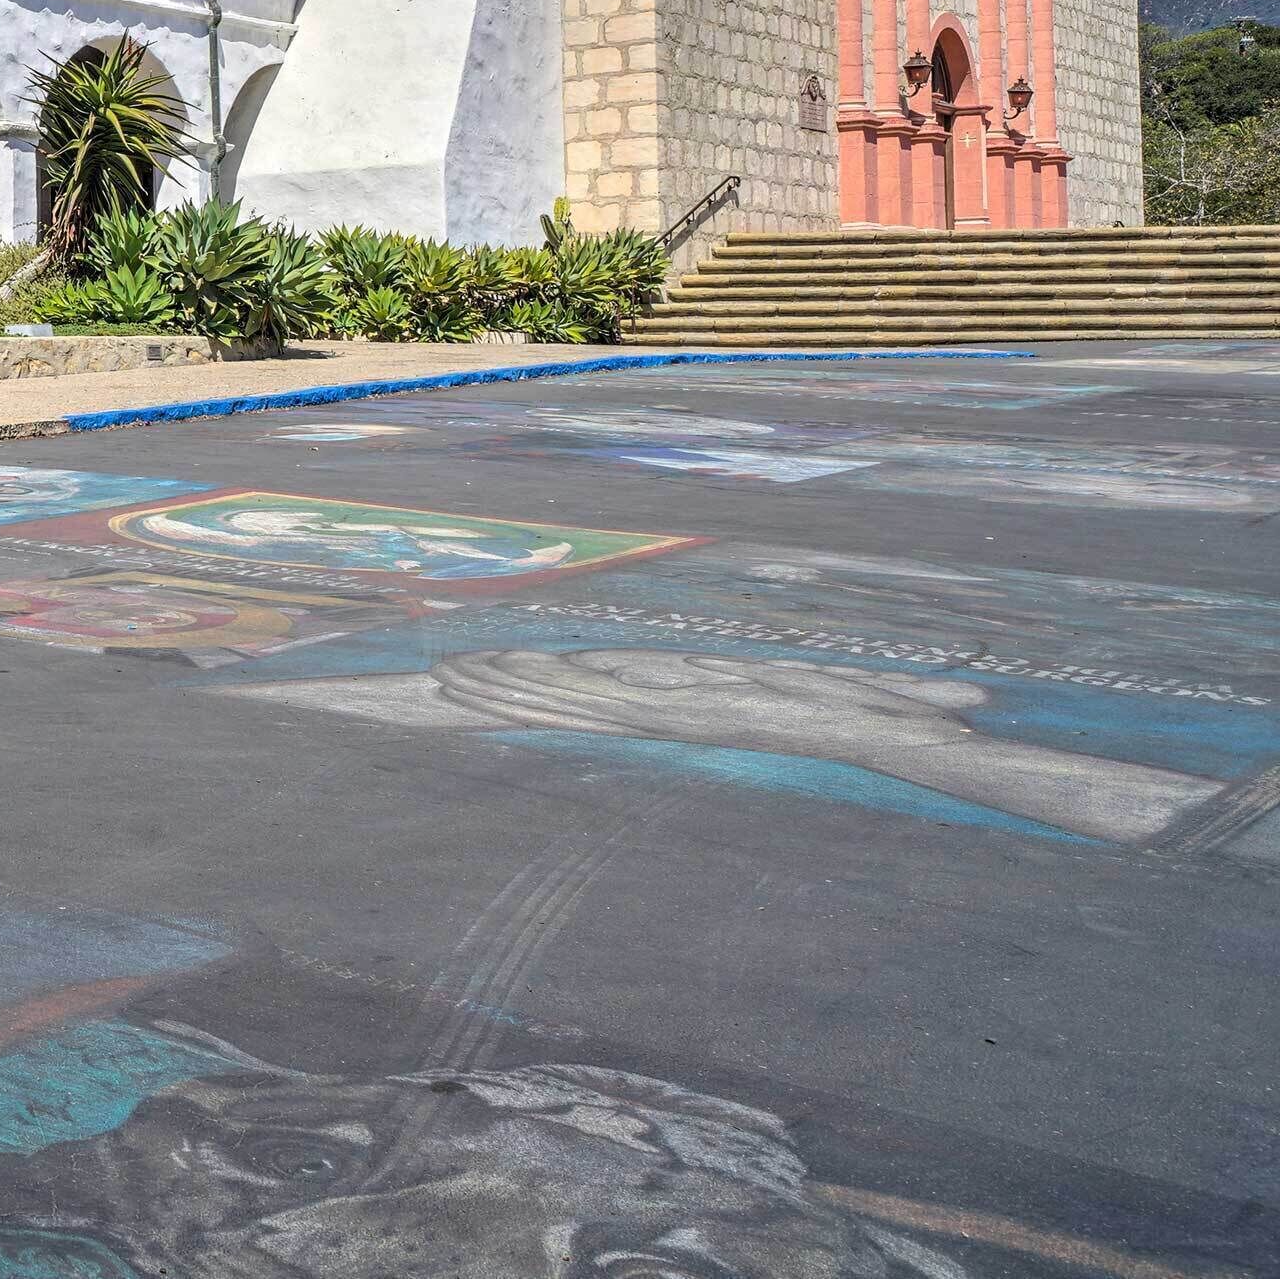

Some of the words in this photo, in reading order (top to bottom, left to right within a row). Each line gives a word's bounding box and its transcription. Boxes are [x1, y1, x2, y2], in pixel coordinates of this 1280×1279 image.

[509, 603, 785, 641] ASSOCIATED
[795, 639, 949, 664] HAND
[961, 661, 1272, 707] SURGEONS
